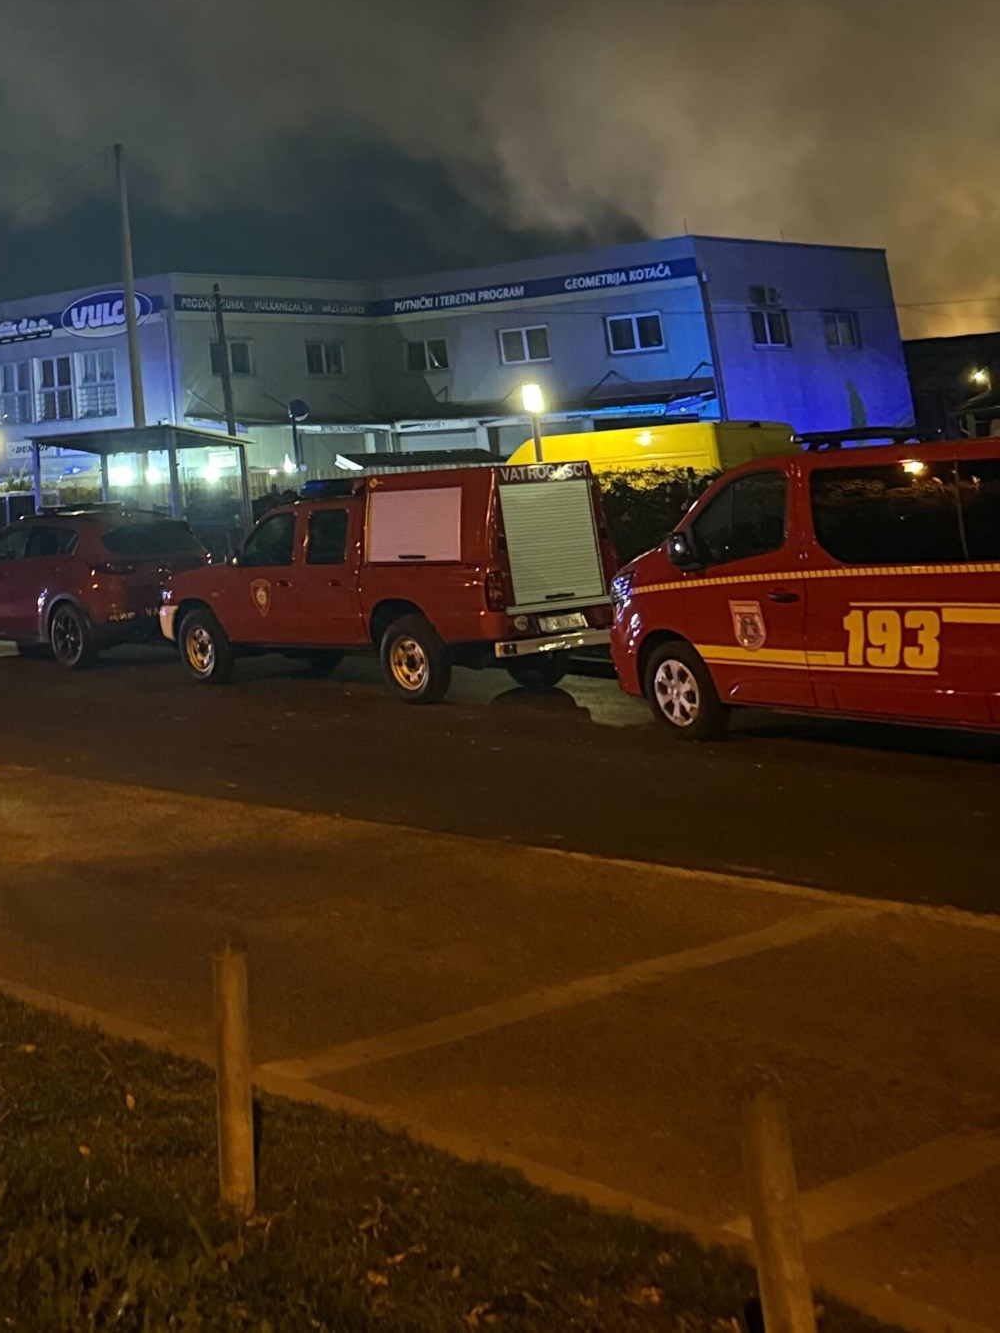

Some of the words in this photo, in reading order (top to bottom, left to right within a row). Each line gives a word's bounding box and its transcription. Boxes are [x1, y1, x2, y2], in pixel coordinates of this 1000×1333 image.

[564, 272, 627, 291] GEOMETRIJA
[629, 263, 672, 282] KOTAČA
[394, 297, 433, 312] PUTNIČKI
[440, 292, 476, 307] TERETNI
[478, 285, 525, 302] PROGRAM
[843, 610, 941, 669] 193
